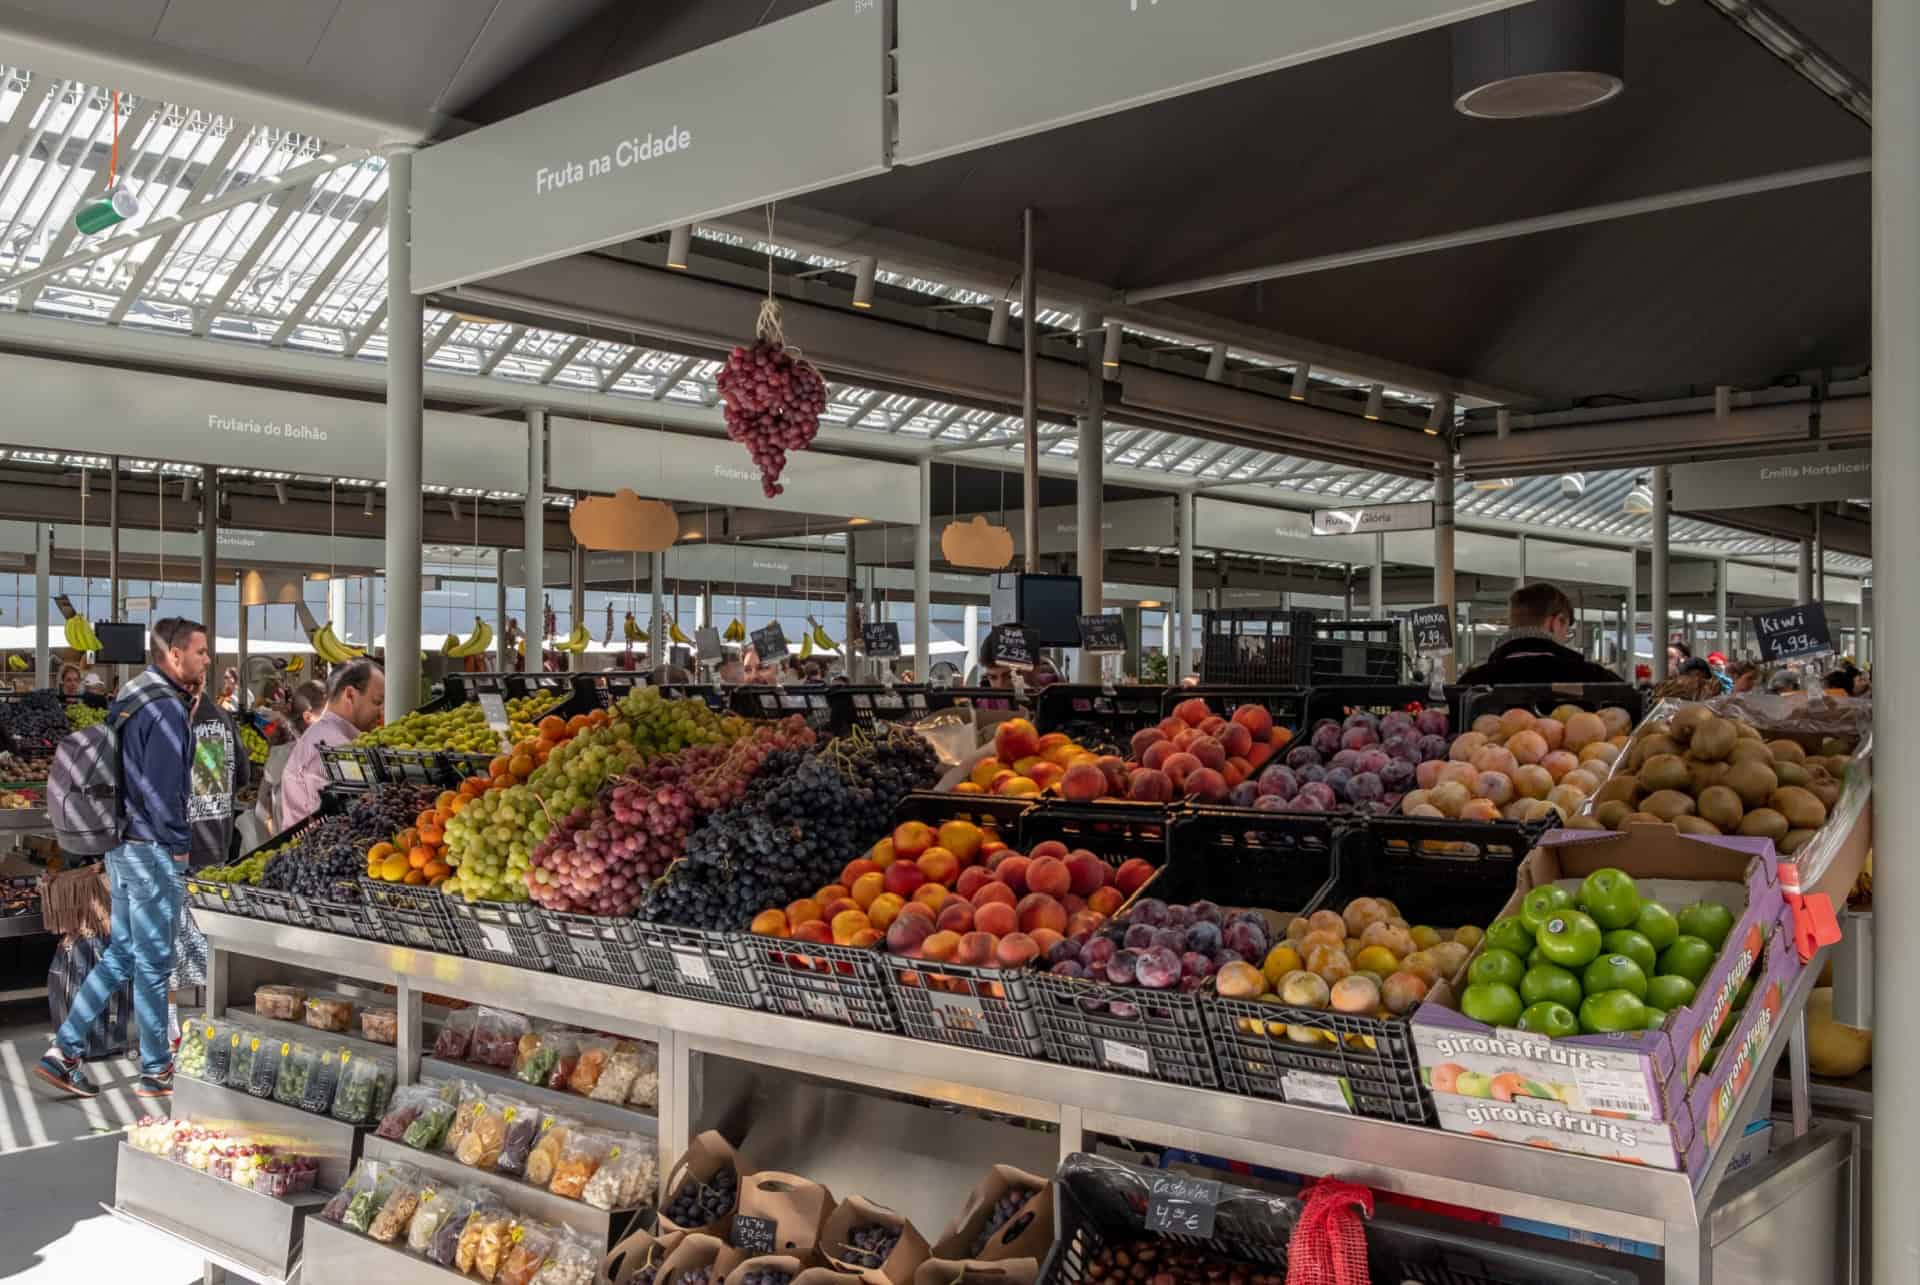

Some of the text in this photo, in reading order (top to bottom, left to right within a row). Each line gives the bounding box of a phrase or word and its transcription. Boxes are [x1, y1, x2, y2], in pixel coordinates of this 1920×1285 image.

[536, 124, 691, 195] Fruta na Cidade
[208, 414, 261, 433] Frutaria
[264, 421, 281, 435] do
[1760, 611, 1804, 634] Kiwi
[1436, 1035, 1607, 1072] gironafruits
[1466, 1103, 1637, 1147] gironafruits
